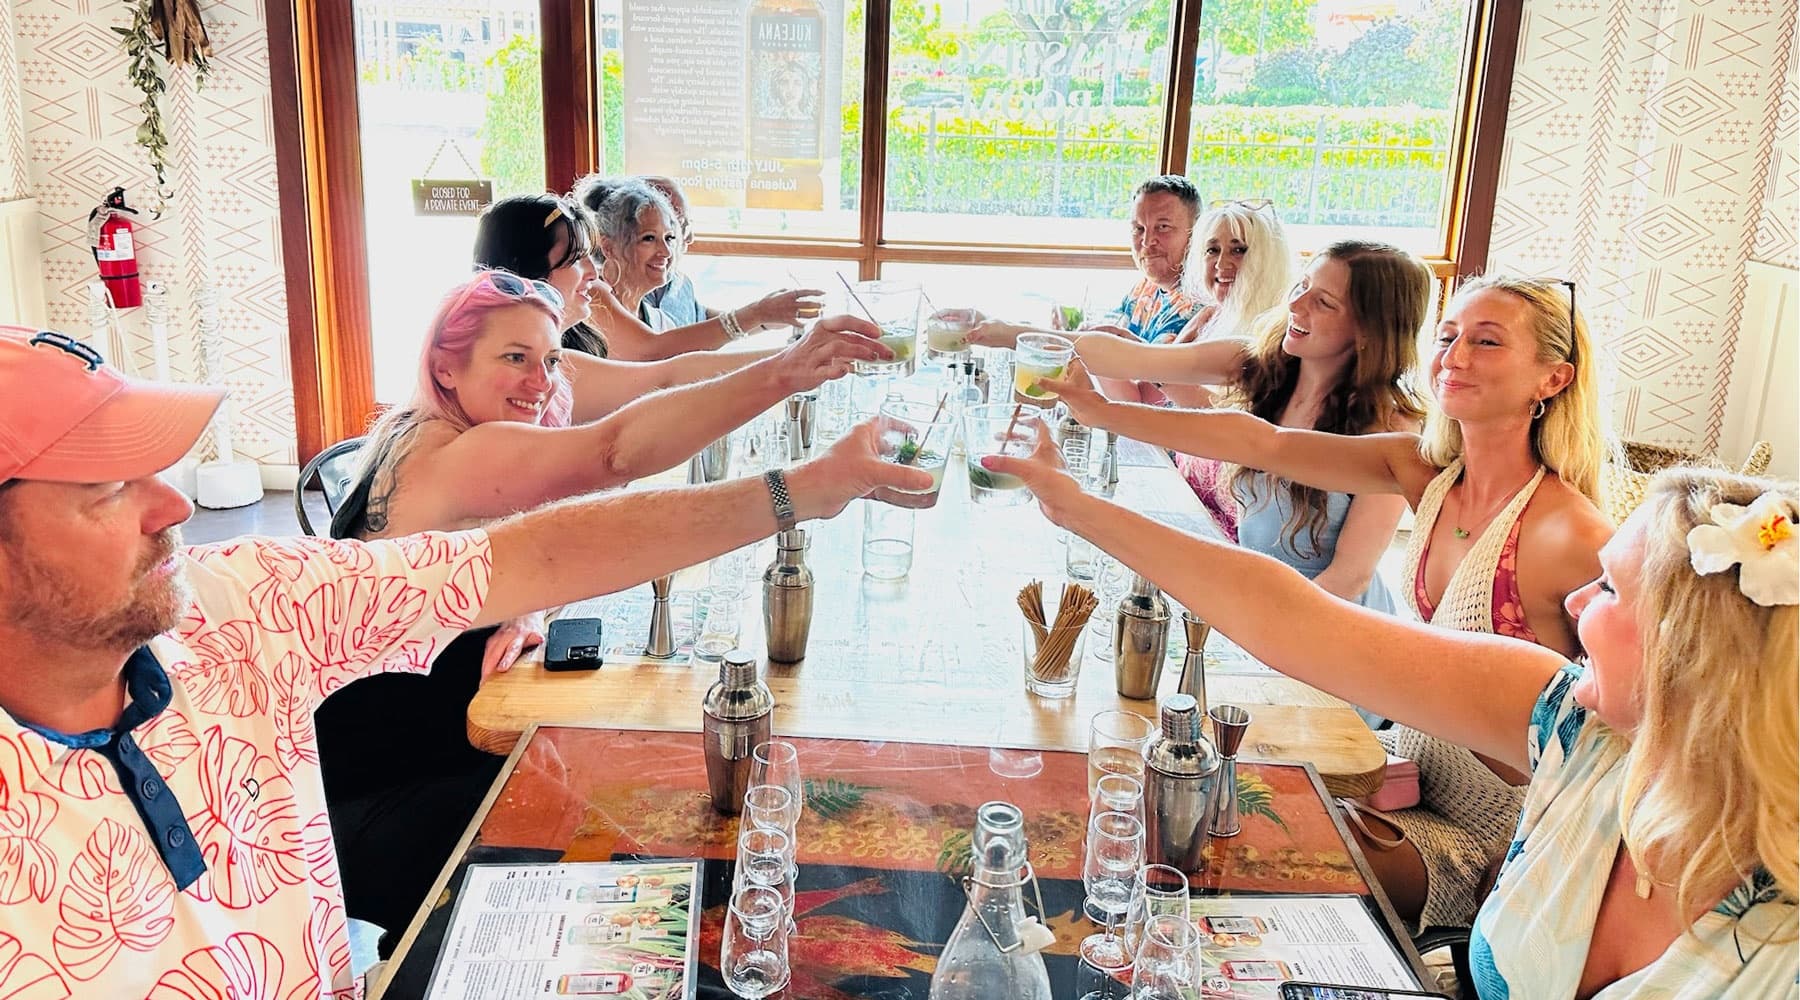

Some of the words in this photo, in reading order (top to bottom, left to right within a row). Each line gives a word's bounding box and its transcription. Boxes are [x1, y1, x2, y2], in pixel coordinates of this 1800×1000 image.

[431, 187, 455, 199] CLOSED
[456, 187, 470, 199] FOR
[424, 199, 430, 211] A
[430, 200, 457, 211] PRIVATE
[459, 199, 480, 211] EVENT
